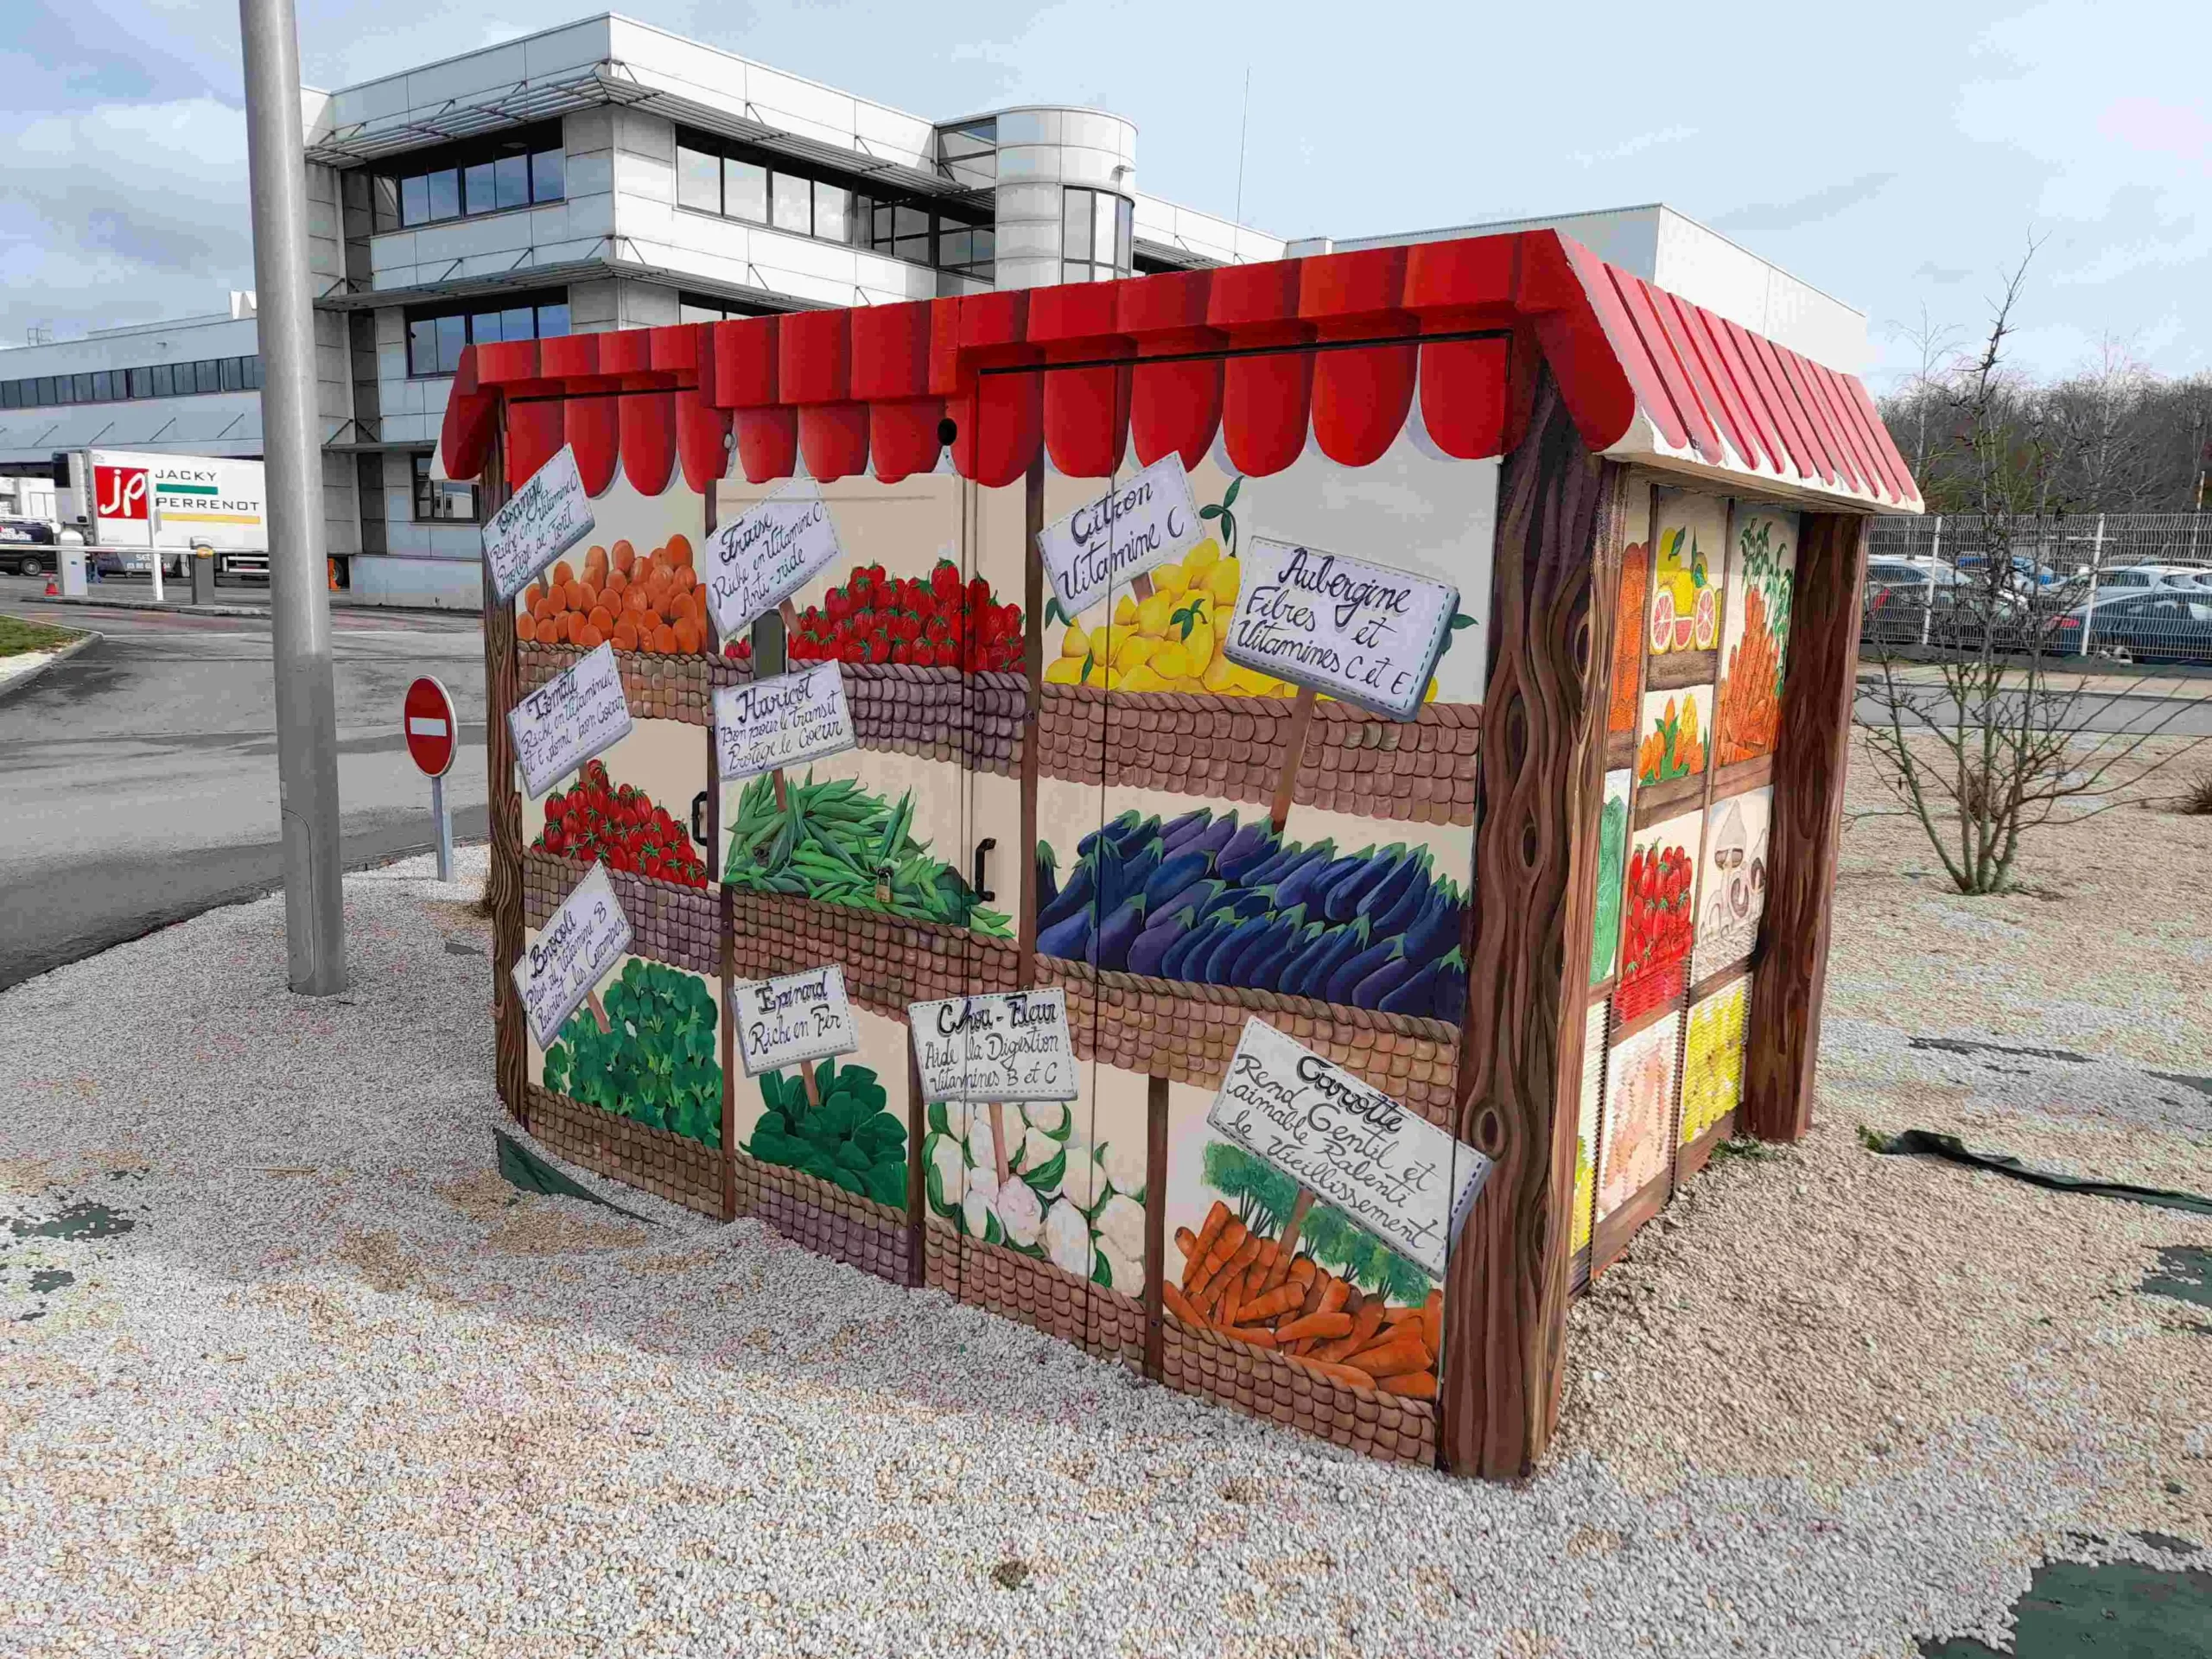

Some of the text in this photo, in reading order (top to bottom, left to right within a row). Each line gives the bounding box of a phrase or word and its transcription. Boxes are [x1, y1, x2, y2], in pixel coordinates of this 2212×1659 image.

[156, 469, 217, 481] JACKY
[156, 498, 259, 512] PERRENOT
[496, 475, 543, 534] Orange
[720, 512, 773, 563] Fraise
[1071, 482, 1154, 544] Citron
[490, 531, 517, 567] Riche
[712, 502, 823, 609] Riche en Vitamine C
[1058, 506, 1184, 600] Vitamine C
[1245, 585, 1397, 649] Fibres et
[1279, 547, 1411, 628] Aubergine
[1237, 620, 1411, 696] Vitamines C et E
[526, 667, 578, 721] Tomate
[736, 672, 821, 724] Haricot
[521, 718, 552, 755] Riche
[554, 713, 566, 729] en
[721, 726, 747, 747] Bon
[749, 721, 780, 744] pour
[779, 709, 788, 731] le
[779, 733, 792, 756] le
[799, 720, 842, 749] Coeur
[530, 909, 576, 979] Brocoli
[556, 919, 594, 973] Vitamine
[594, 900, 607, 924] B
[572, 963, 587, 991] les
[585, 917, 625, 969] Crampes
[748, 1003, 842, 1055] Riche en Fer
[925, 1027, 1058, 1071] Aide la Digestion
[930, 1062, 1058, 1092] Vitamines B et C
[1296, 1055, 1408, 1134] Carotte
[1226, 1084, 1415, 1209] aimable Ralenti
[1236, 1054, 1441, 1192] Rend Gentil et
[1229, 1110, 1442, 1249] le Vieillissement
